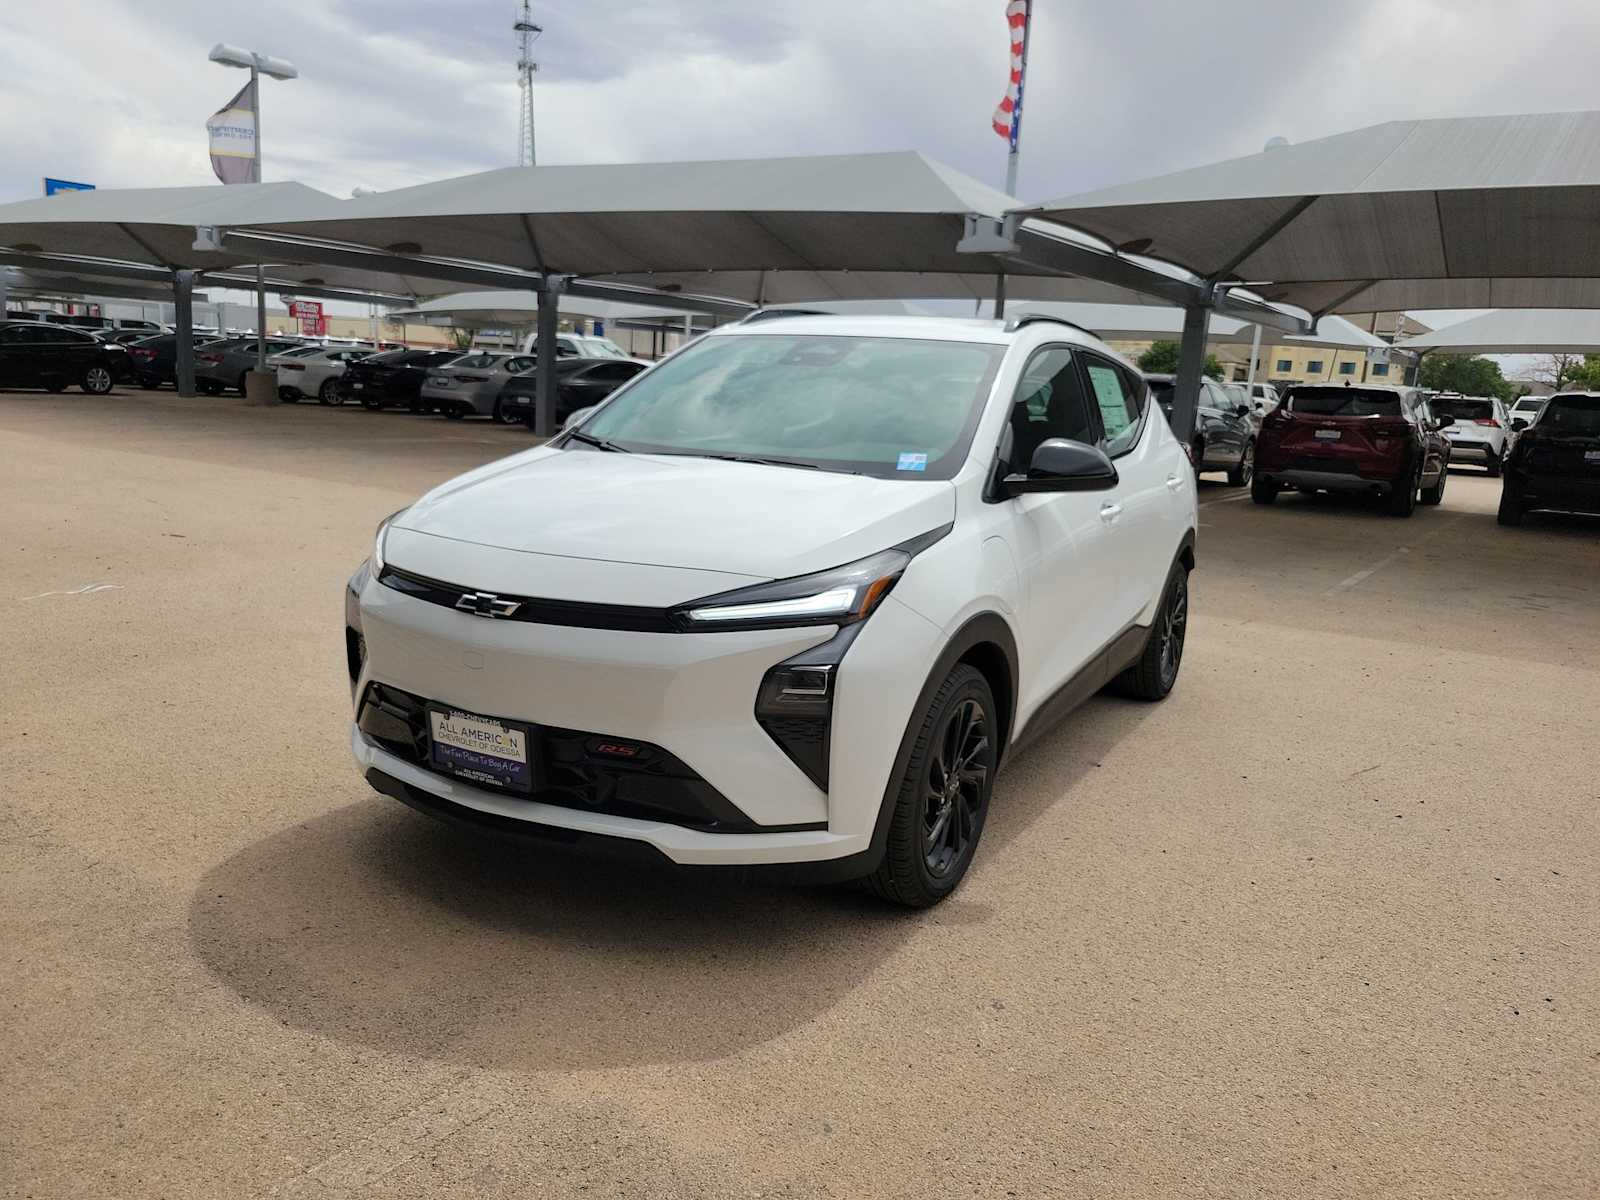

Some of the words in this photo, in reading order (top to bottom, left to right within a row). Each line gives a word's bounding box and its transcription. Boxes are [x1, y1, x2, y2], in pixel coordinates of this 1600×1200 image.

[440, 721, 457, 735] ALL
[439, 731, 478, 747] CHEVROLET
[480, 742, 489, 751] OF
[491, 744, 520, 758] ODESSA
[597, 744, 636, 756] RS
[463, 751, 479, 762] Place
[480, 757, 488, 765] To
[488, 759, 502, 770] Buy
[502, 762, 508, 770] A
[509, 763, 520, 773] Car
